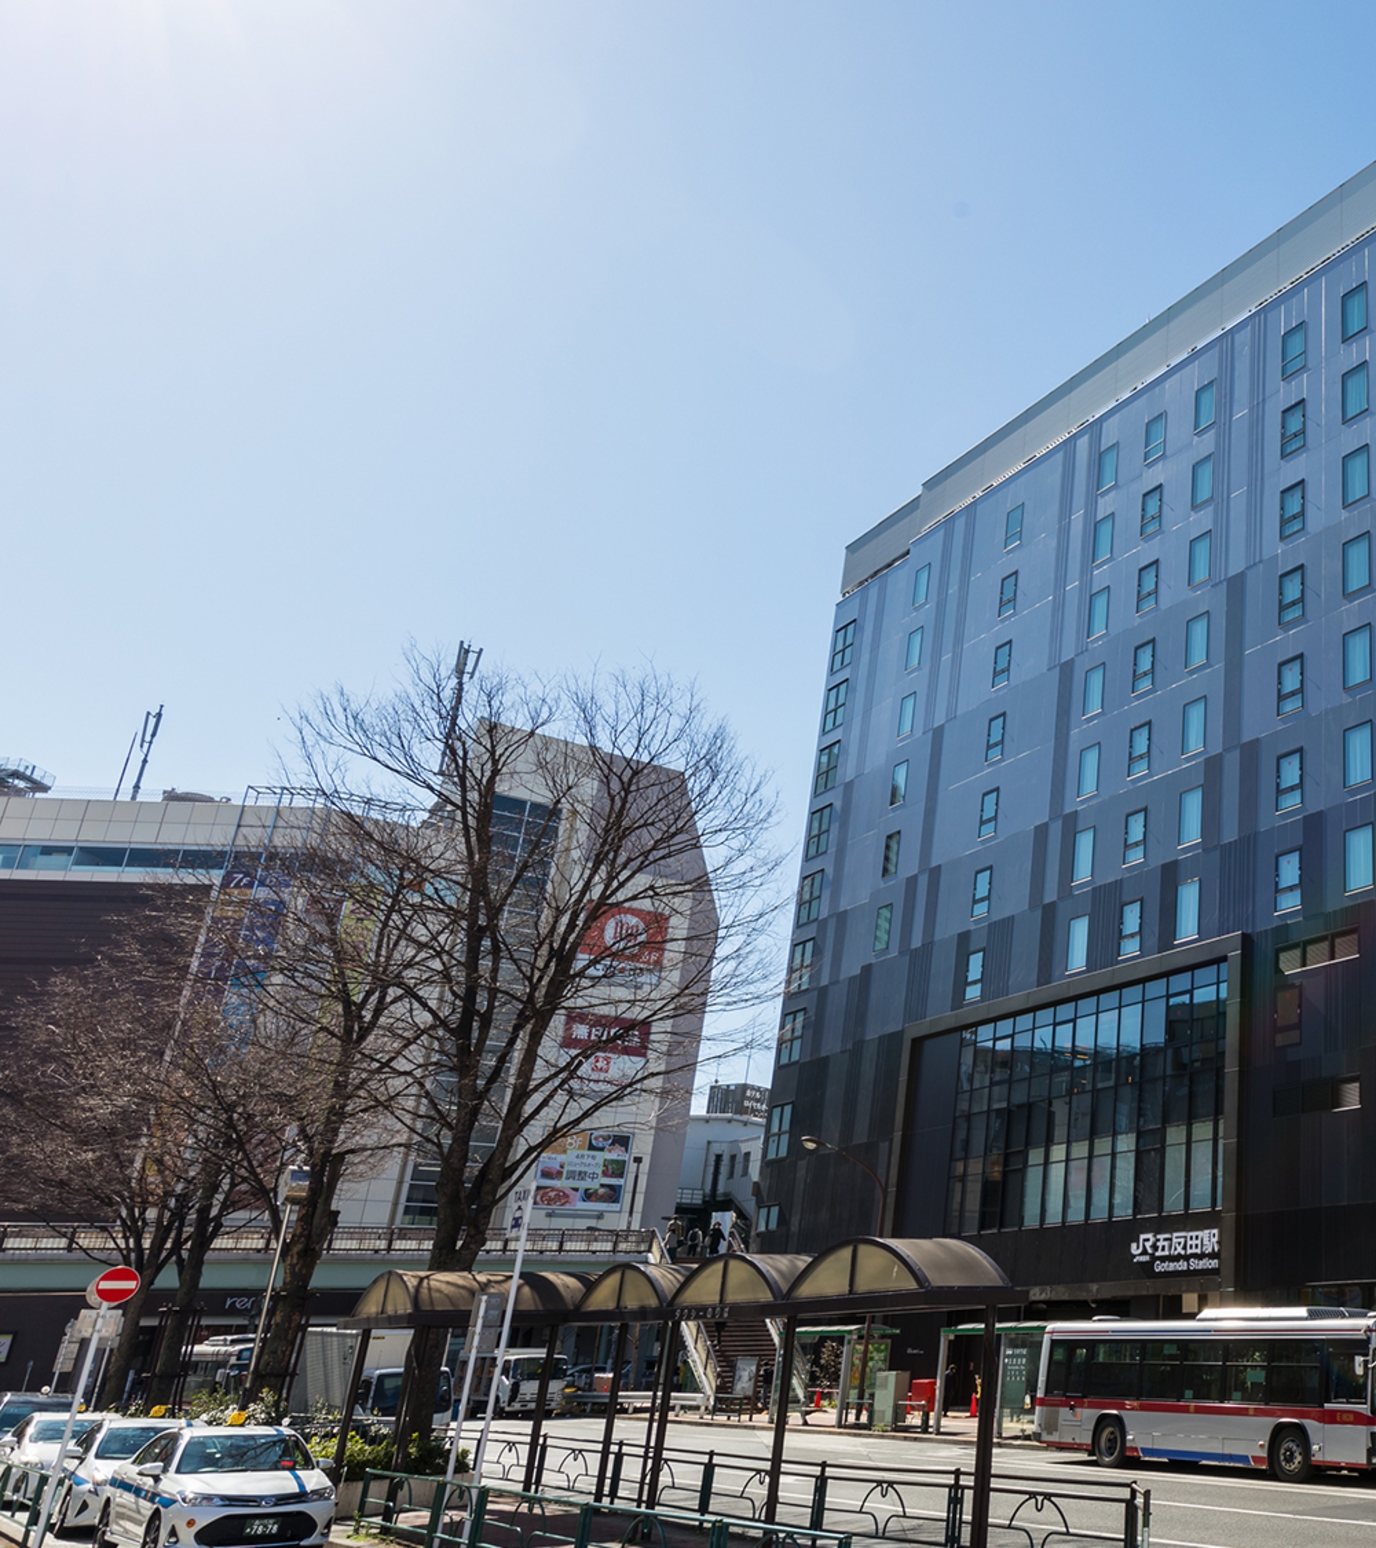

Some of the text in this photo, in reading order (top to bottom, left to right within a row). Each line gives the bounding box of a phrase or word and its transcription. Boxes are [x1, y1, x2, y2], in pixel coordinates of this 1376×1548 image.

[565, 1169, 600, 1182] 調整中
[1155, 1229, 1219, 1256] 五反田駅
[1154, 1257, 1219, 1272] Gotanda Station
